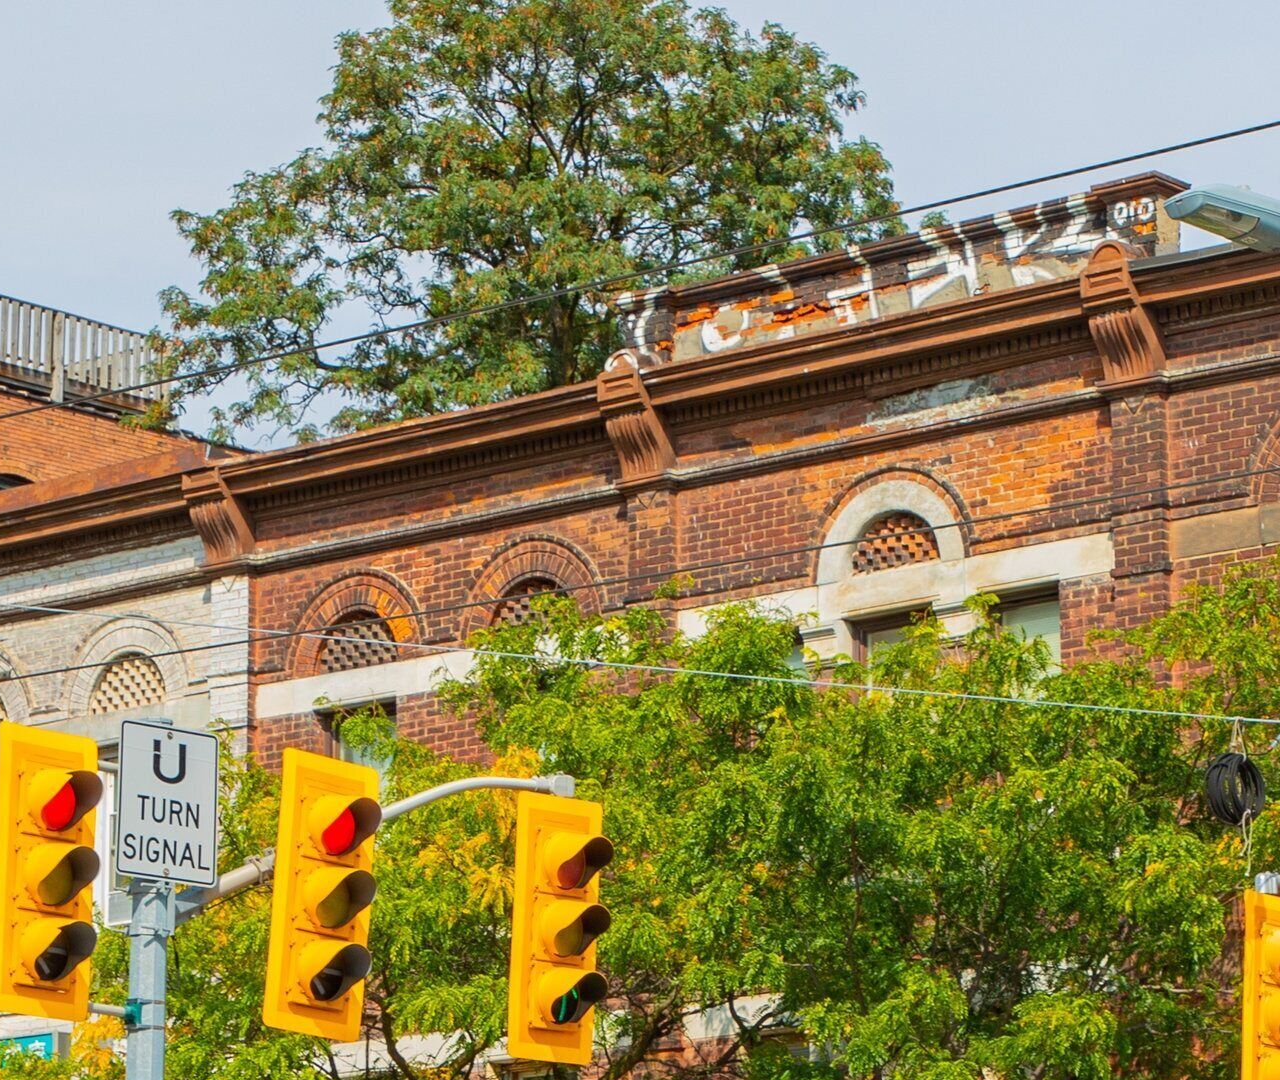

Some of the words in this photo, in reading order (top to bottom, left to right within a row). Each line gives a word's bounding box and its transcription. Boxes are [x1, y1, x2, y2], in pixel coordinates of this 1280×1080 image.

[153, 739, 187, 784] U
[136, 794, 201, 830] TURN
[122, 832, 212, 872] SIGNAL
